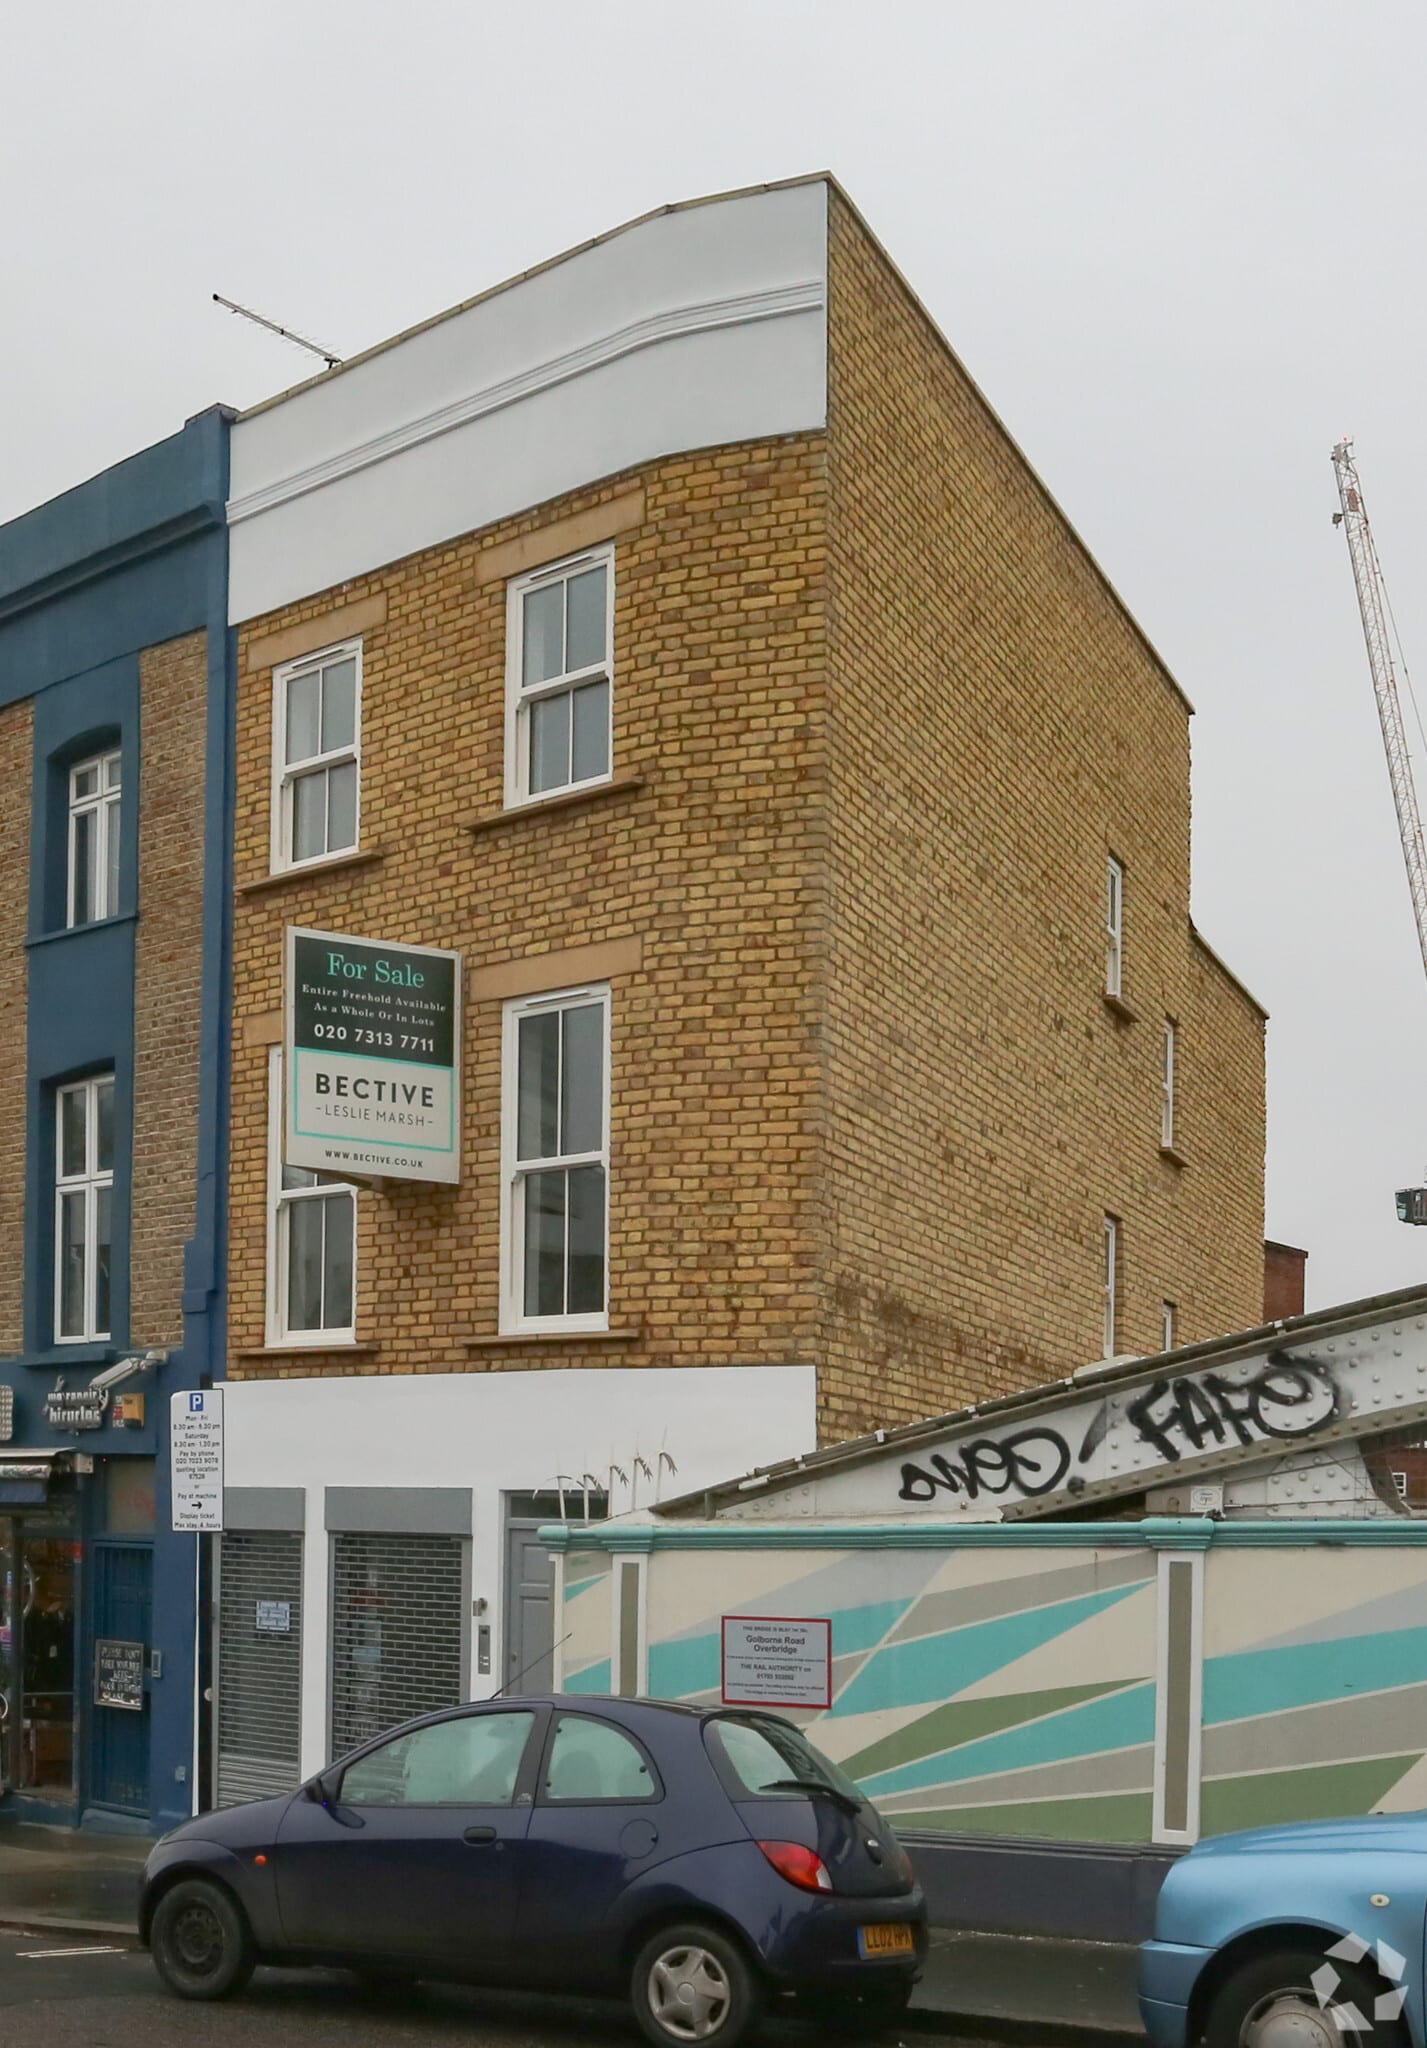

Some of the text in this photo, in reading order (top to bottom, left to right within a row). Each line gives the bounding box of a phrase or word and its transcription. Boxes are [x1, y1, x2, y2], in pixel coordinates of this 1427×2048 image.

[327, 952, 425, 989] For Sale
[302, 983, 447, 1013] Entire Freehold Available
[314, 1002, 328, 1012] As
[341, 1005, 375, 1018] Whole
[378, 1011, 393, 1021] Or
[396, 1015, 408, 1023] In
[412, 1016, 435, 1027] Lots
[314, 1023, 435, 1052] 020 7313 7711
[315, 1072, 434, 1108] BECTIVE
[325, 1150, 424, 1168] WWW.BECTIVE.CO.UK
[193, 1394, 202, 1411] P
[179, 1450, 189, 1458] Pay
[177, 1492, 187, 1500] Pay
[746, 1635, 805, 1645] Golborne Road
[754, 1644, 797, 1655] Overbridge
[768, 1664, 802, 1672] AUTHORITY
